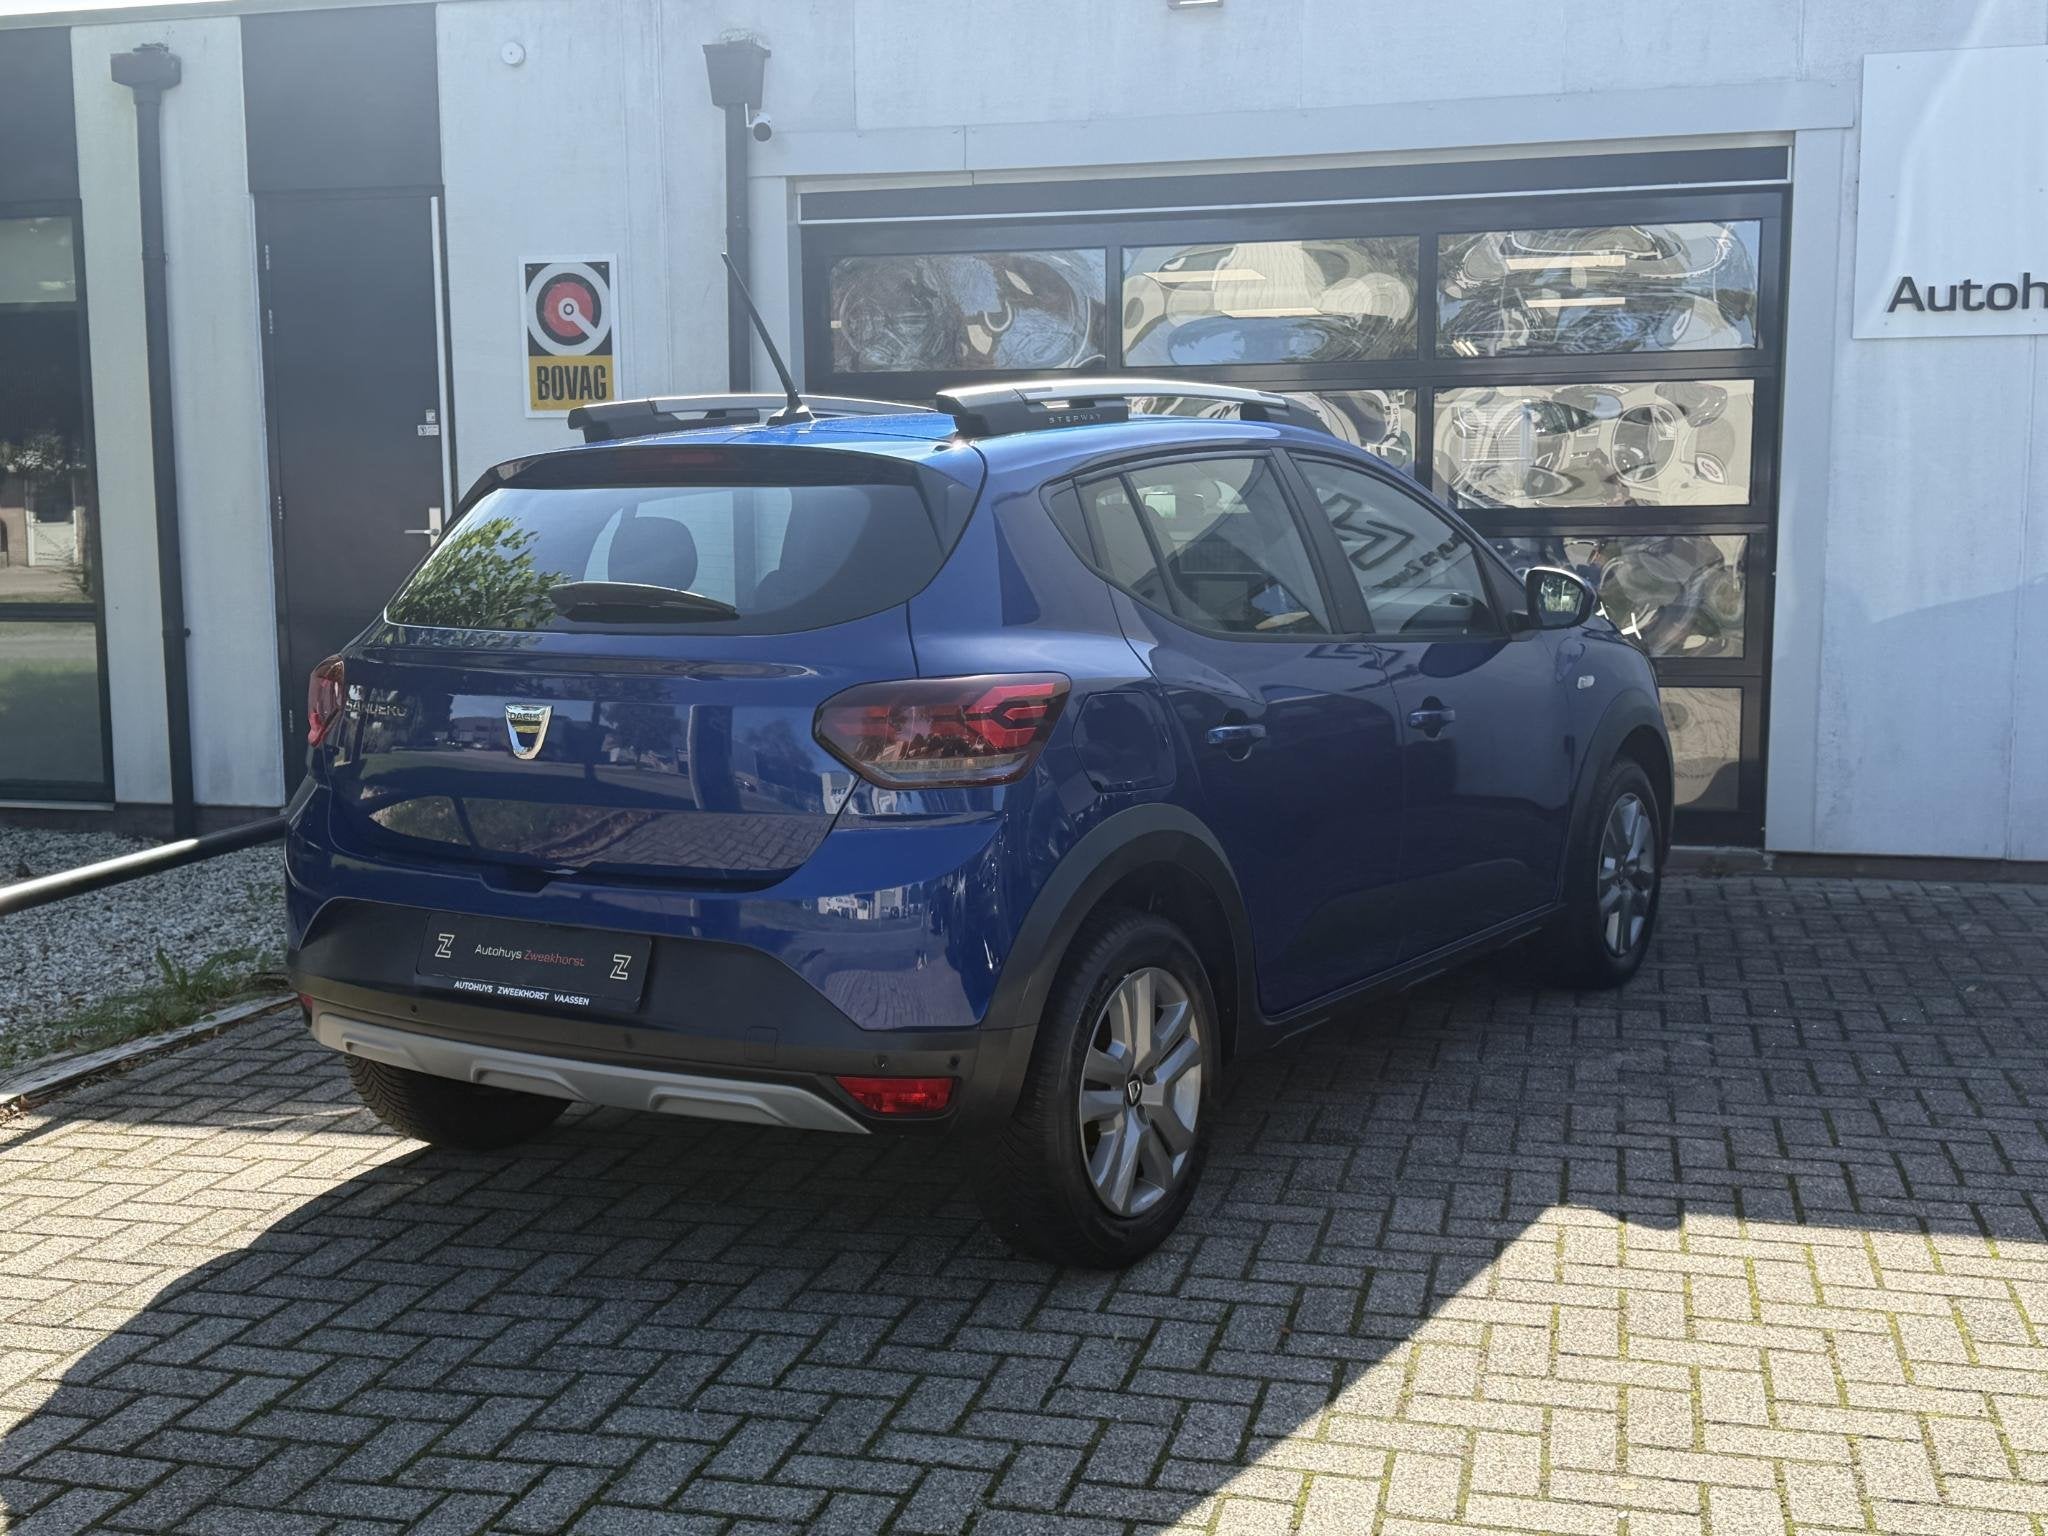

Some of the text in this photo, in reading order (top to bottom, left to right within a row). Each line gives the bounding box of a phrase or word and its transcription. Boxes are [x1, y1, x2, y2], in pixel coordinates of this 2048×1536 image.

[1887, 272, 2048, 313] Autoh
[536, 364, 608, 401] BOVAG
[1048, 413, 1101, 424] STEPWAY
[454, 980, 590, 1006] AUTOHUYS ZWEEKHORST VAASSEN
